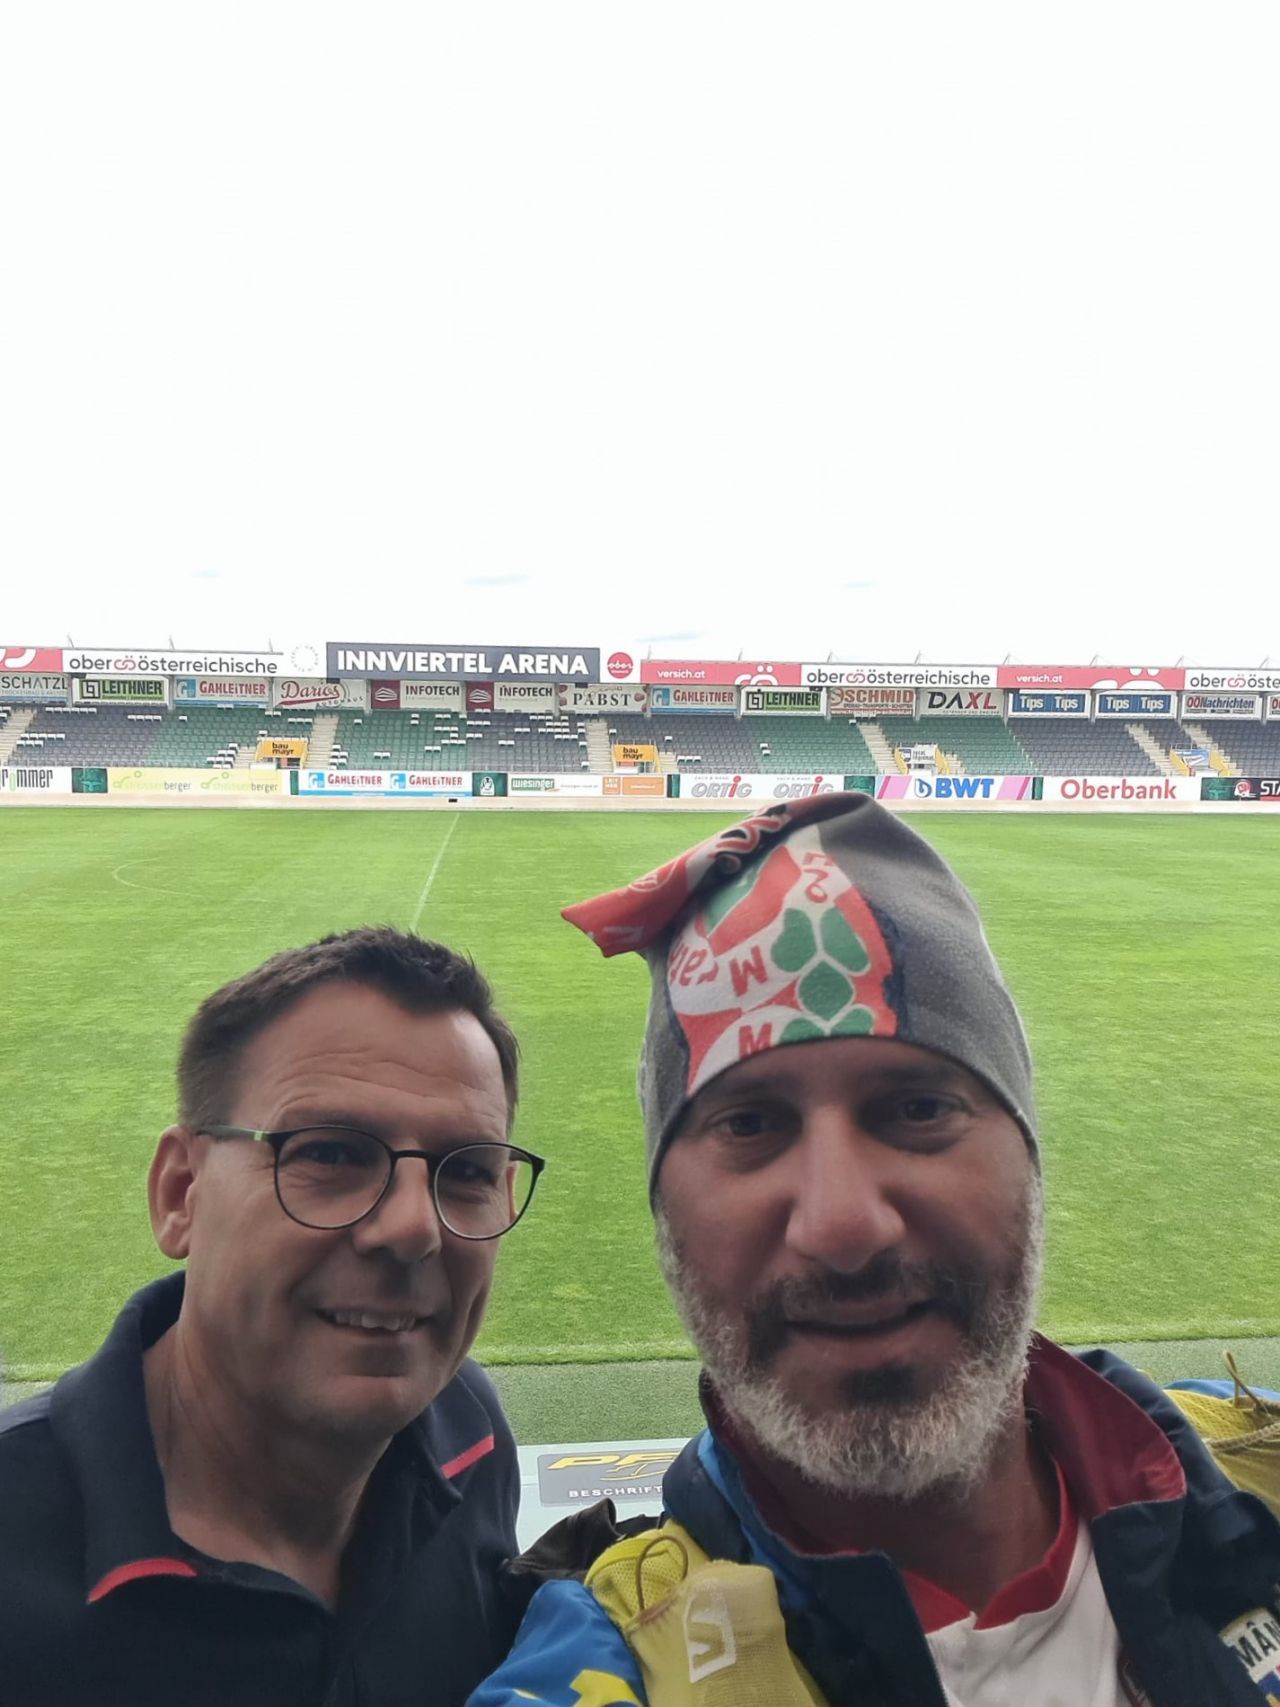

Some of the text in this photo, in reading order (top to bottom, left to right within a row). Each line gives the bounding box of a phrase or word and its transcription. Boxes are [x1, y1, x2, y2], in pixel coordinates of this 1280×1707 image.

[337, 650, 589, 675] INNVIERTEL ARENA
[656, 669, 705, 679] versich.at
[1016, 674, 1063, 683] versich.at
[102, 680, 163, 695] LEITHNER
[405, 685, 460, 696] INFOTECH
[499, 686, 553, 697] INFOTECH
[573, 692, 632, 706] PABST
[766, 692, 819, 706] LEITHNER
[844, 688, 914, 704] SCHMID
[927, 691, 997, 710] DAXL
[1020, 695, 1079, 711] Tips Tips
[1106, 696, 1164, 712] Tips Tips
[272, 742, 289, 750] bau
[272, 748, 295, 756] mayr
[935, 778, 995, 799] BWT
[1060, 778, 1177, 800] Oberbank
